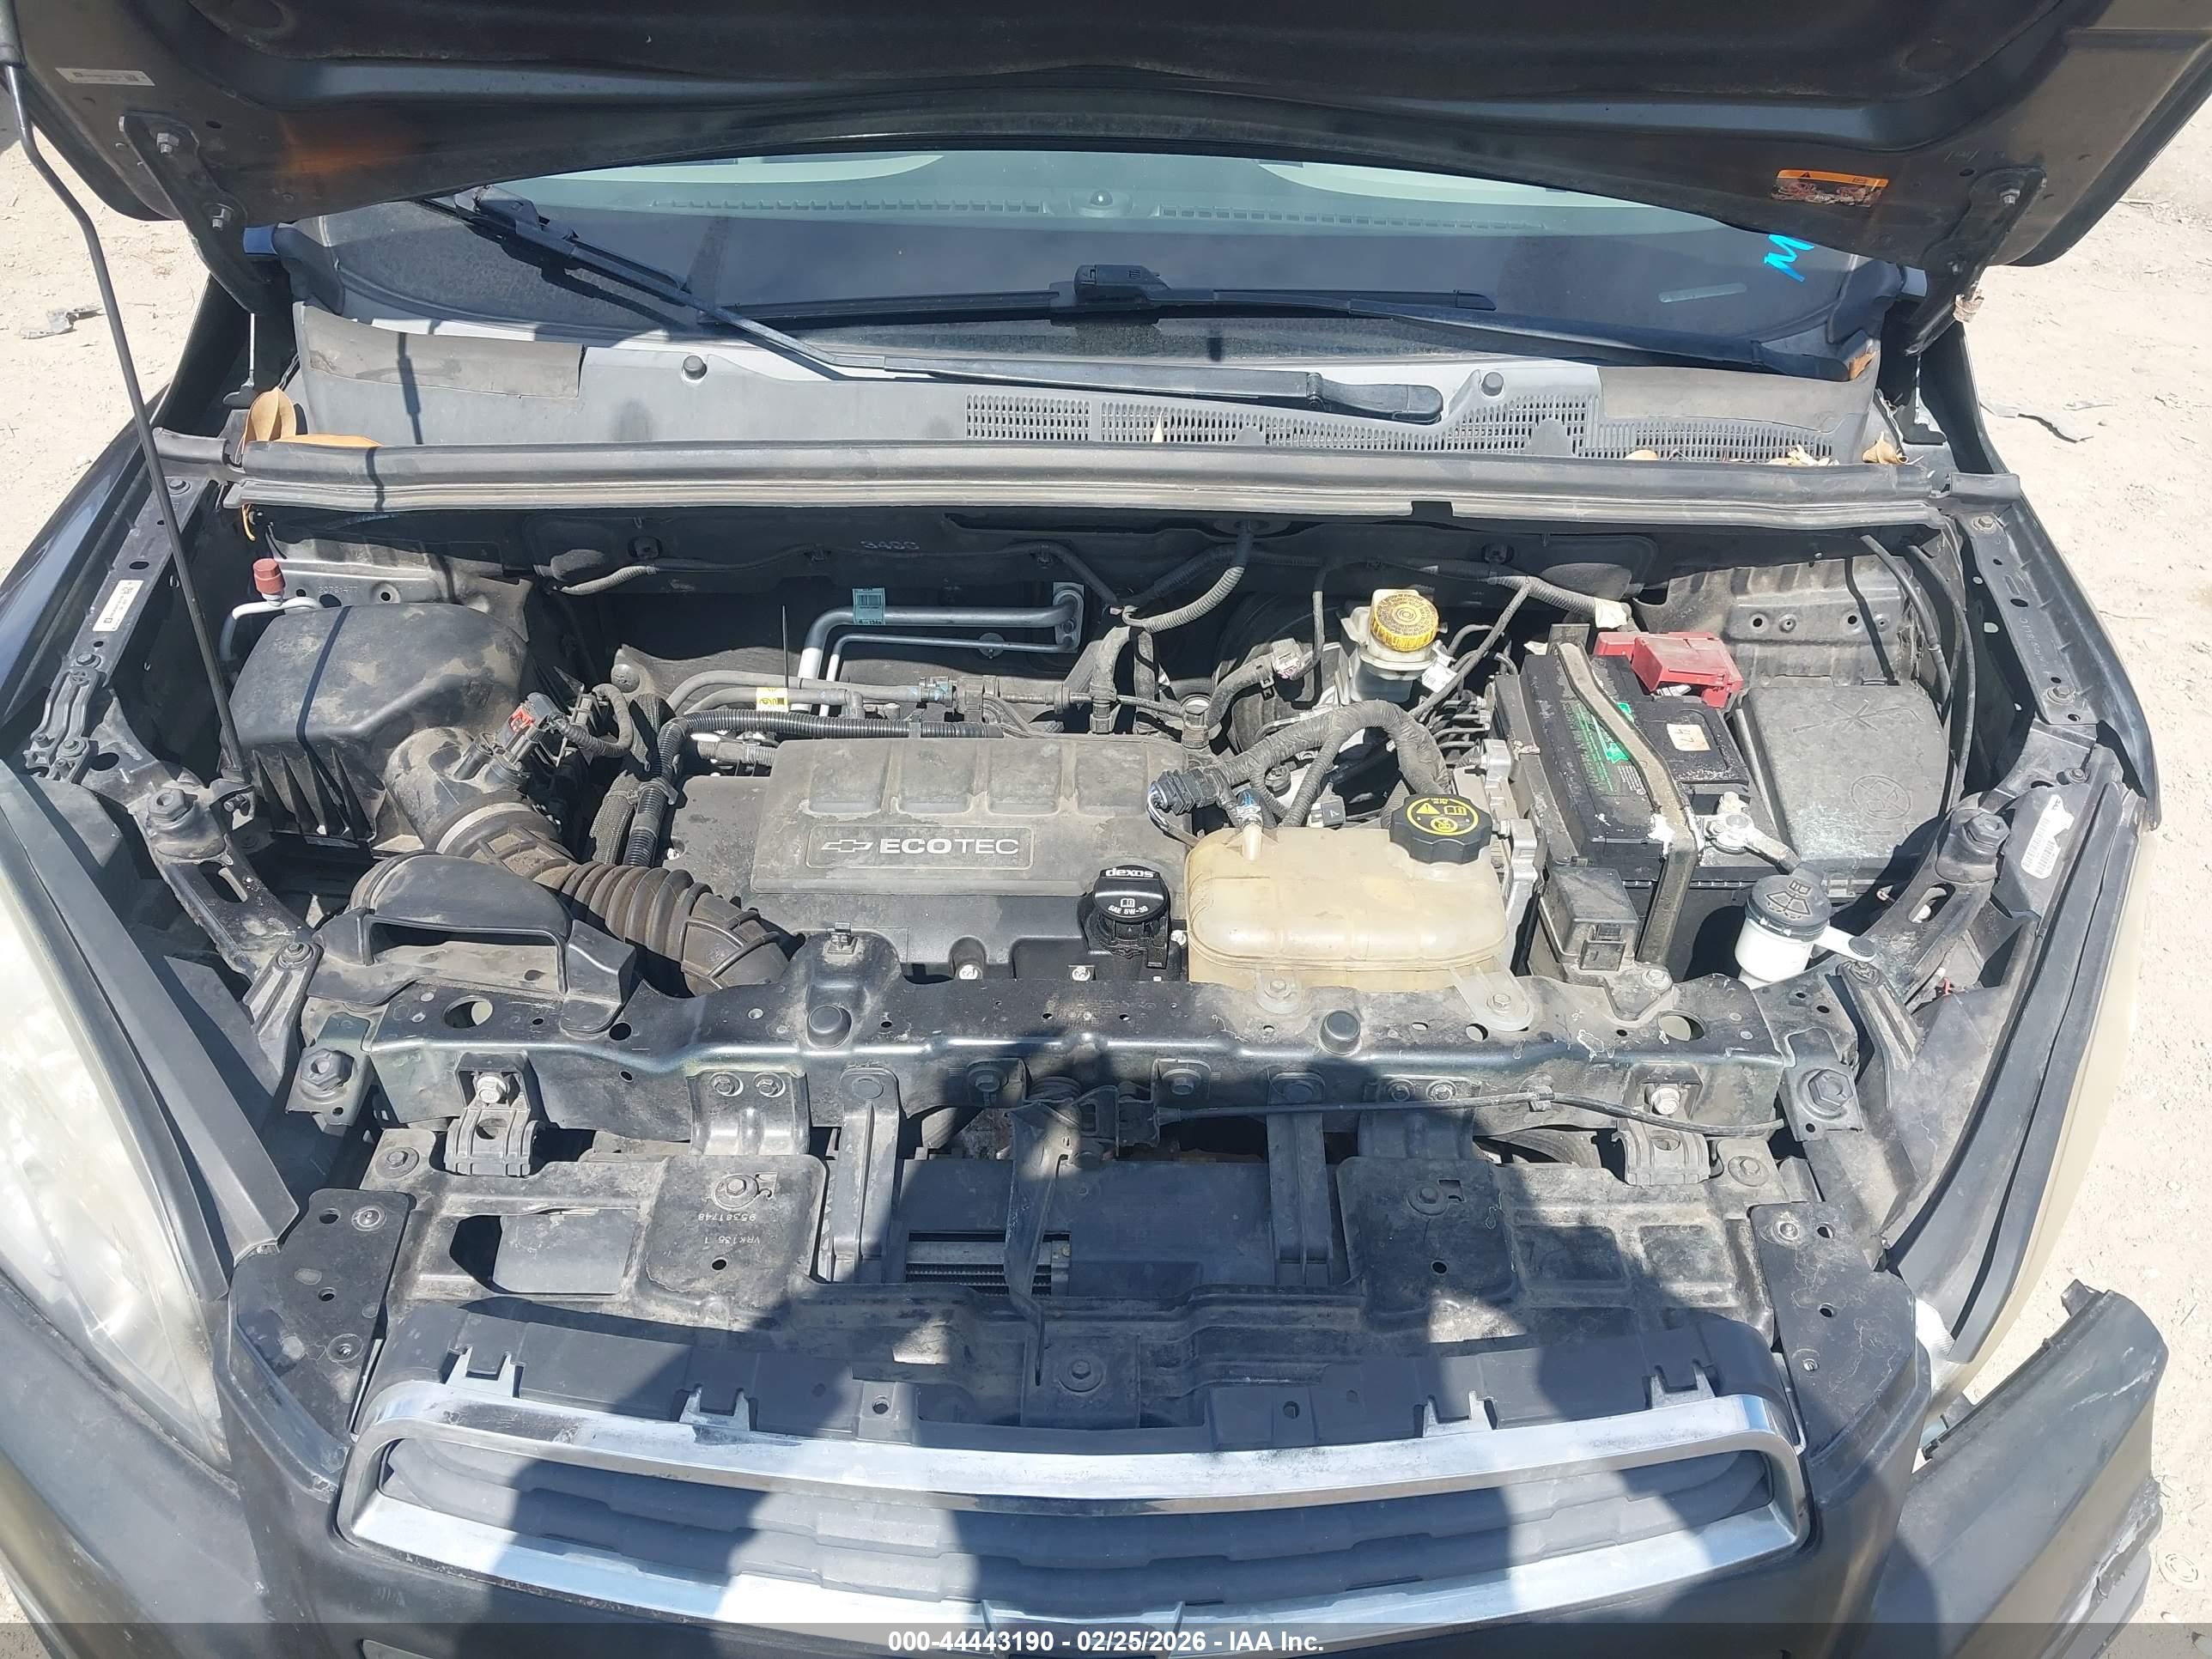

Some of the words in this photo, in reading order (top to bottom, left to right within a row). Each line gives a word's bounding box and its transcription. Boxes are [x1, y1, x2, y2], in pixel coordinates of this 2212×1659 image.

[879, 838, 1019, 854] ECOTEC
[1105, 867, 1155, 878] dexos
[1108, 904, 1122, 915] SAE
[1123, 905, 1149, 915] 5W-30
[698, 1212, 757, 1222] 95381748
